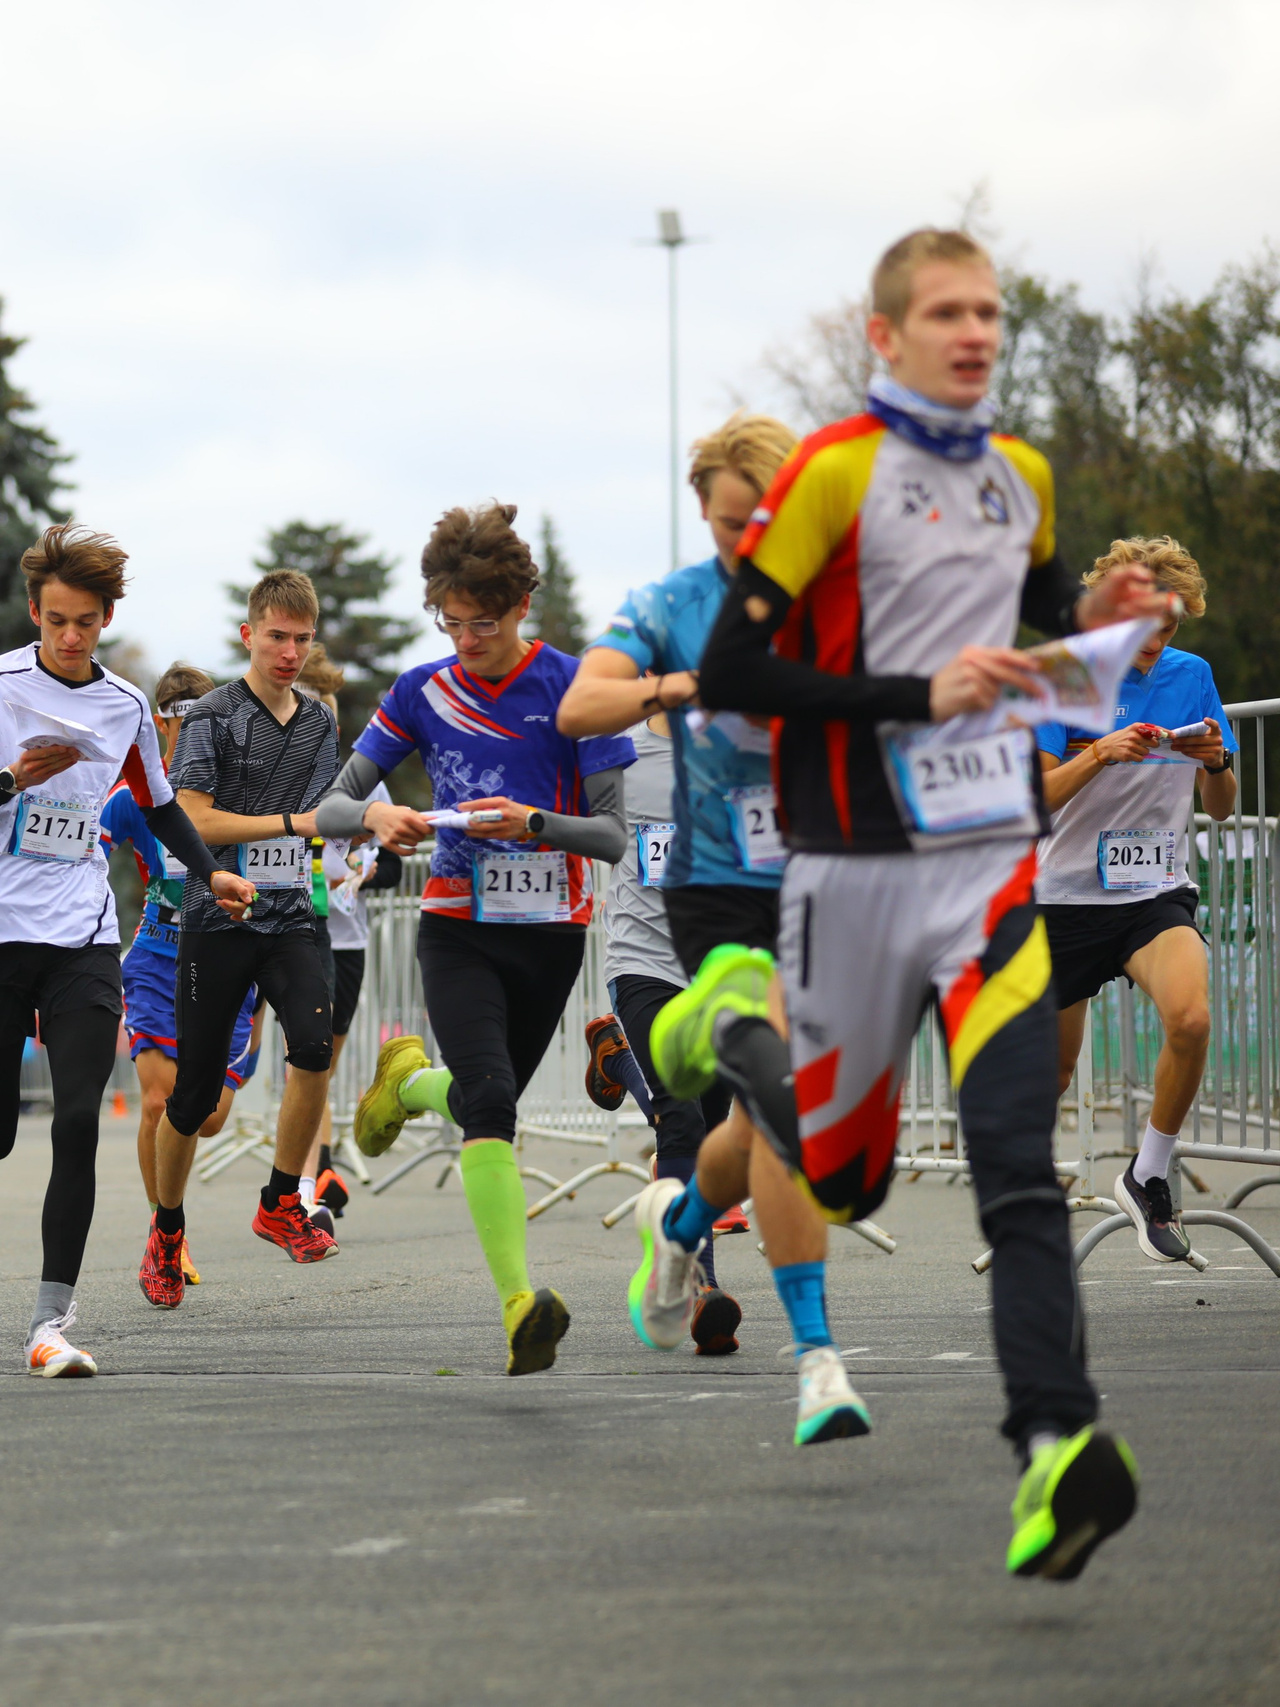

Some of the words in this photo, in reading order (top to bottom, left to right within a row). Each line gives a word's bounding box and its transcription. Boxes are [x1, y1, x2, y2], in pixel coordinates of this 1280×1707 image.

[916, 744, 1011, 791] 230.1
[26, 813, 86, 841] 217.1
[248, 848, 296, 867] 212.1
[1108, 845, 1162, 866] 202.1
[486, 869, 552, 893] 213.1
